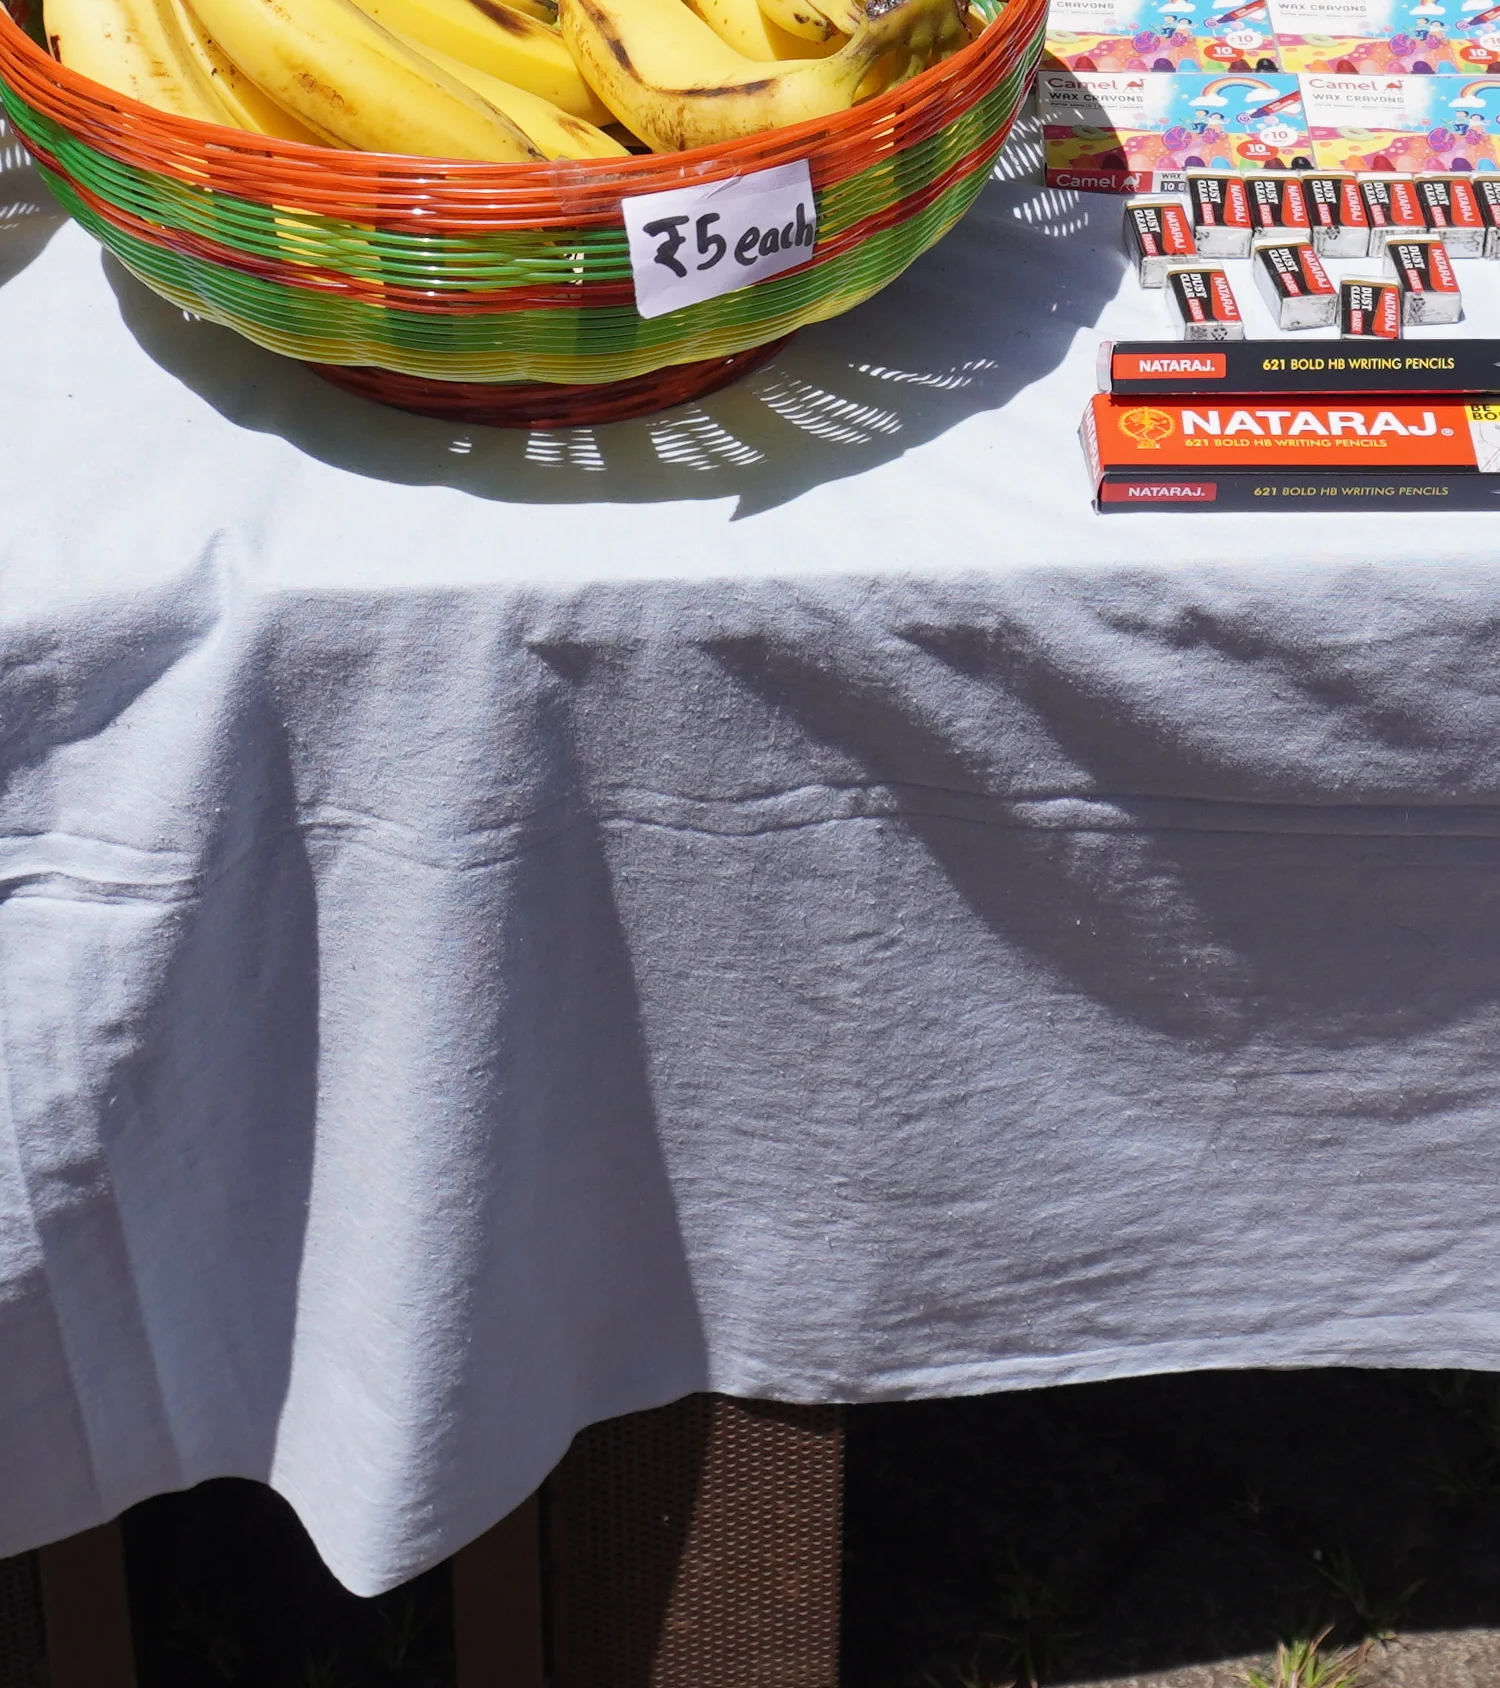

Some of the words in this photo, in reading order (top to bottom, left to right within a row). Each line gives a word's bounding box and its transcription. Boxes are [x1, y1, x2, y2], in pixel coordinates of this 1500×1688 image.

[1310, 4, 1366, 12] CRAYONS
[1049, 78, 1116, 89] Camel
[1309, 78, 1377, 91] Camel
[1050, 92, 1079, 101] WAX
[1084, 93, 1143, 102] CRAYONS
[1347, 95, 1404, 103] CRAYONS
[1057, 174, 1116, 188] Camel
[1207, 180, 1221, 204] DUST
[1264, 181, 1278, 204] DUST
[1322, 180, 1337, 204] DUST
[1230, 185, 1247, 222] NATARAJ
[1287, 186, 1304, 222] NATARAJ
[1345, 184, 1362, 222] NATARAJ
[1373, 183, 1389, 204] DUST
[1393, 183, 1414, 220] NATARAJ
[1433, 183, 1449, 205] DUST
[1454, 186, 1475, 222] NATARAJ
[1144, 210, 1160, 233] DUST
[1164, 211, 1186, 249] NATARAJ
[734, 203, 812, 266] each
[1277, 248, 1299, 272] DUST
[1408, 245, 1425, 269] DUST
[1432, 249, 1454, 287] NATARAJ
[1302, 250, 1330, 289] NATARAJ
[1190, 274, 1207, 298] DUST
[1214, 277, 1236, 316] NATARAJ
[1361, 287, 1372, 311] DUST
[1384, 293, 1396, 332] NATARAJ
[1263, 360, 1286, 370] 621
[1291, 359, 1324, 370] BOLD
[1329, 359, 1345, 370] HB
[1348, 359, 1402, 370] WRITING
[1406, 358, 1455, 369] PENCILS
[1185, 439, 1209, 447] 621
[1214, 439, 1250, 447] BOLD
[1254, 439, 1272, 447] HB
[1276, 439, 1332, 447] WRITING
[1336, 439, 1387, 447] PENCILS
[1254, 488, 1278, 496] 621
[1282, 488, 1316, 496] BOLD
[1321, 487, 1338, 496] HB
[1341, 487, 1395, 496] WRITING
[1399, 487, 1448, 495] PENCILS
